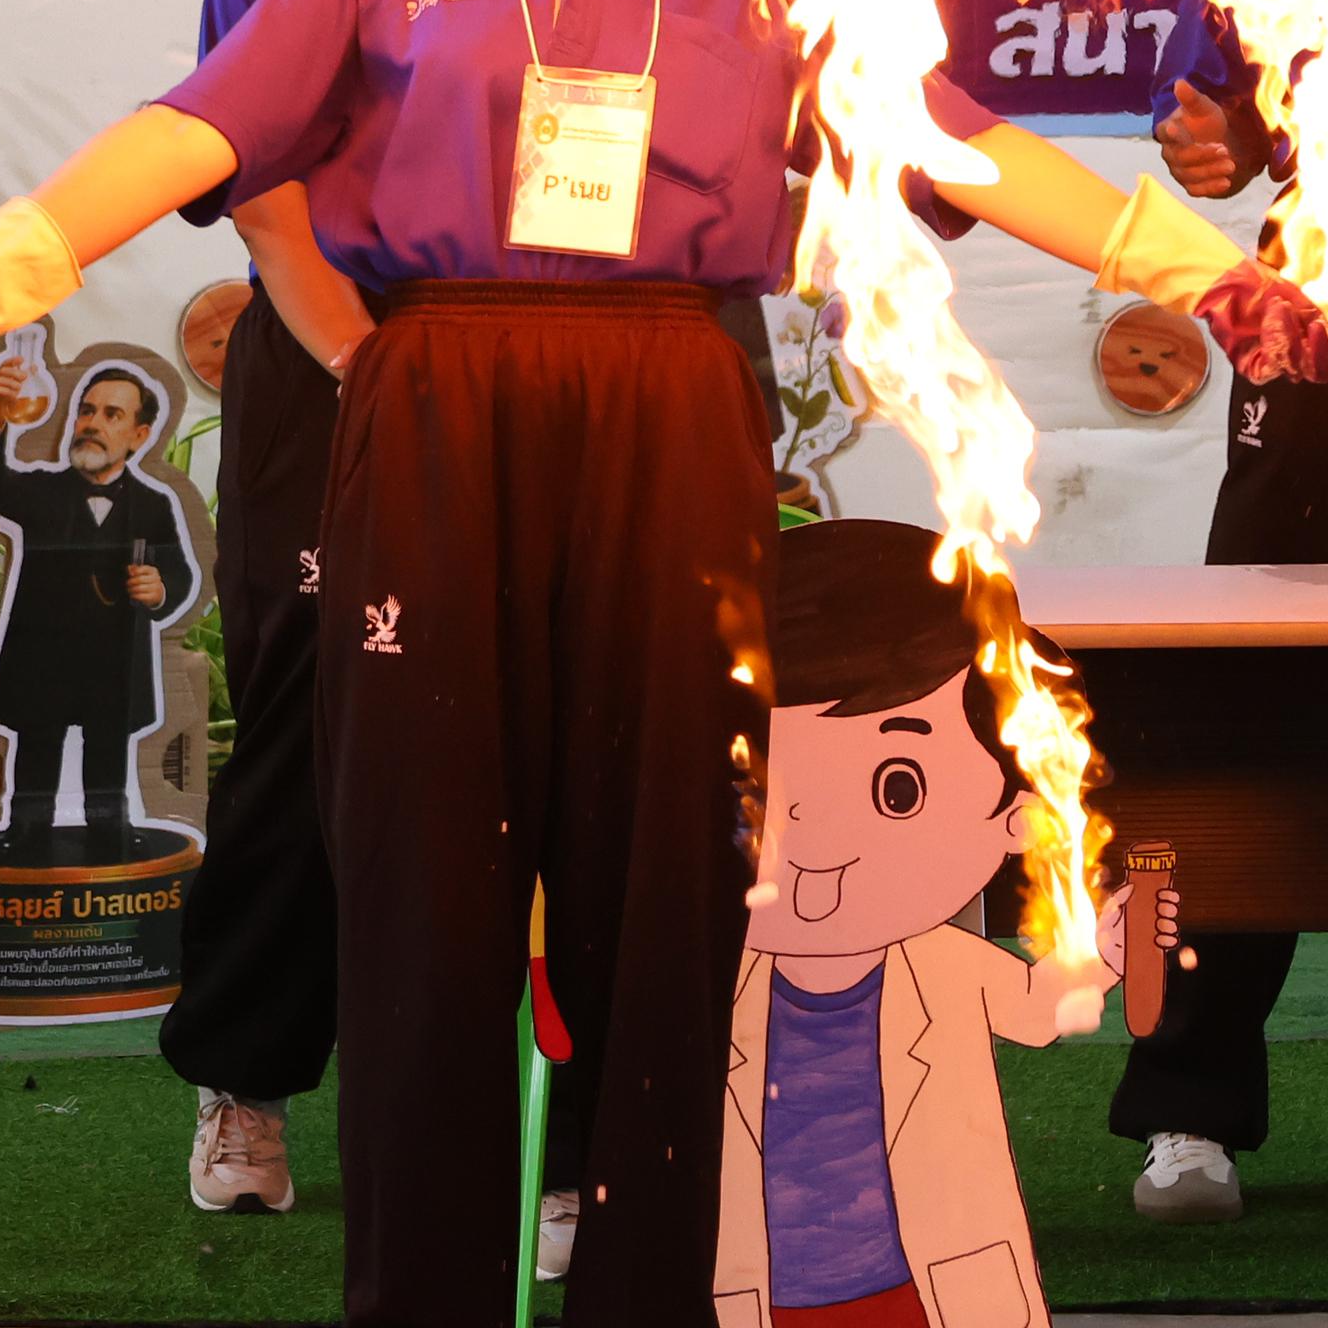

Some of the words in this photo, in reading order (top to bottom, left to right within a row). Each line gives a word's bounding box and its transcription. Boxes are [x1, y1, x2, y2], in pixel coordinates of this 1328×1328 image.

[539, 83, 639, 105] STAFF
[363, 641, 376, 652] FLY
[378, 643, 403, 654] HAWK
[73, 881, 182, 918] ปาสเตอร์
